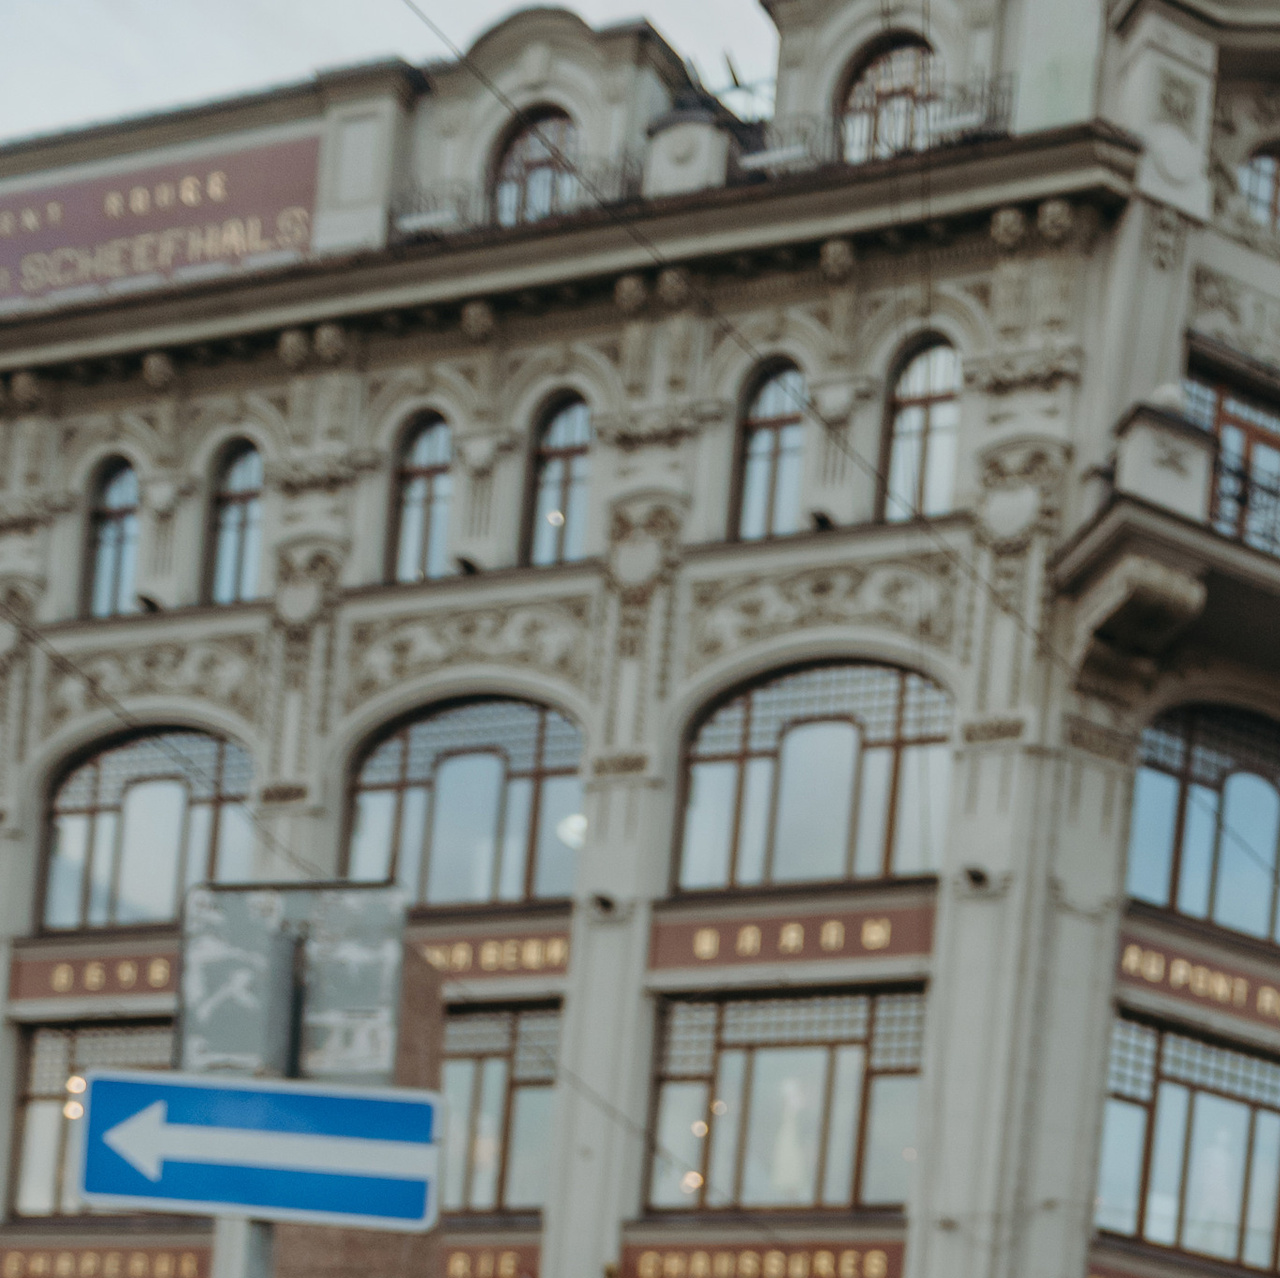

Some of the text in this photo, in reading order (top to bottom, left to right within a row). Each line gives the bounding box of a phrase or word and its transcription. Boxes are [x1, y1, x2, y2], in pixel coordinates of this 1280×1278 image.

[692, 916, 892, 960] ШЛЯПЫ
[51, 957, 172, 992] ОБУВ
[1121, 944, 1166, 984] AU
[1169, 958, 1250, 1006] PONT
